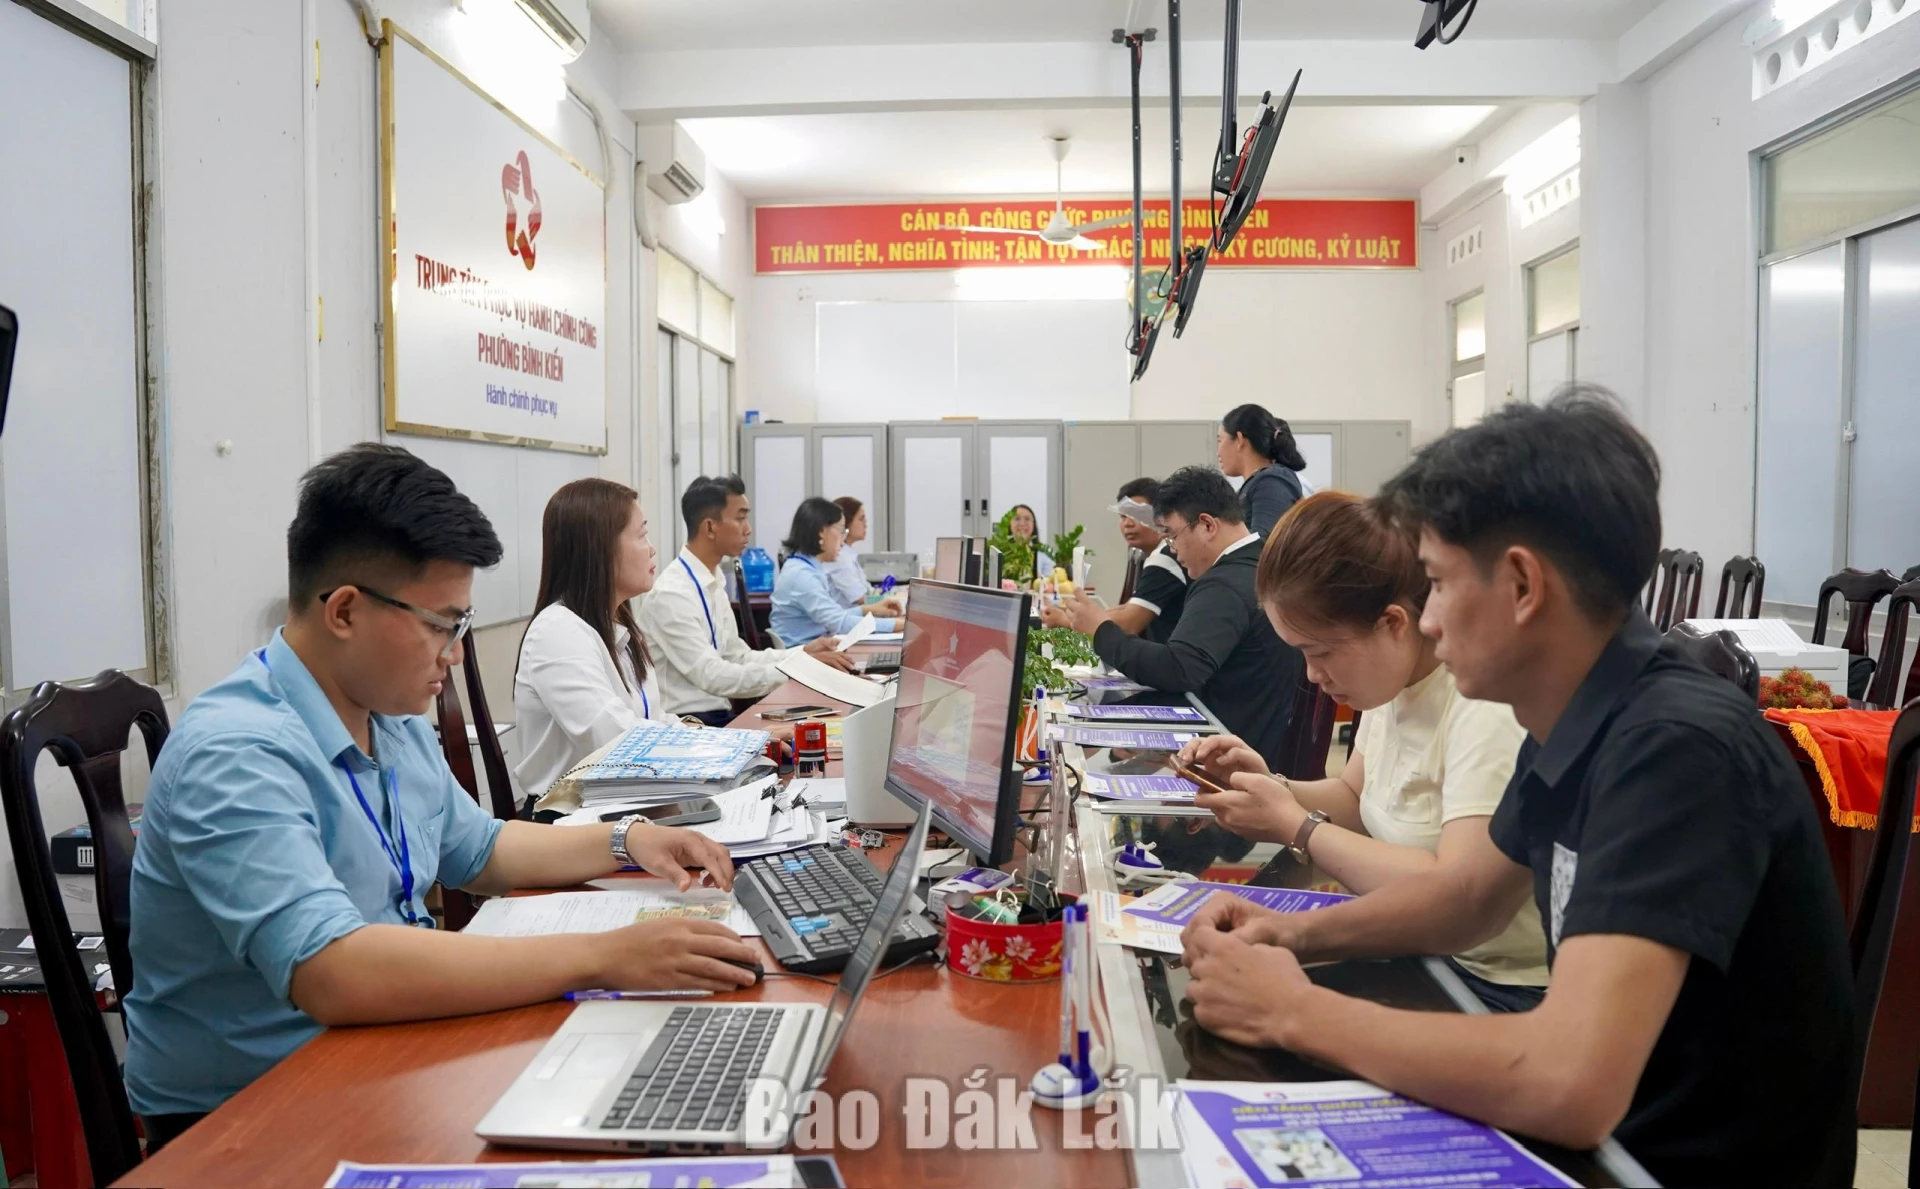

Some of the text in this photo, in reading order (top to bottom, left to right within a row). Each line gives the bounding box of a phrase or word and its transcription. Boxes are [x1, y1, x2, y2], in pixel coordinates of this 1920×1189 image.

[901, 208, 940, 231] CÁN
[980, 207, 1032, 231] CÔNG
[1036, 206, 1087, 229] CỨC
[1092, 207, 1170, 228] PHƯNG
[771, 241, 819, 265] THÂN
[825, 239, 884, 266] THIỆN,
[889, 237, 947, 261] NGHĨA
[951, 237, 1000, 262] TÌNH;
[1004, 236, 1042, 264] TẬN
[1224, 232, 1248, 258] KỶ
[1252, 236, 1322, 260] CƯƠNG,
[1327, 233, 1350, 259] KỶ
[1355, 236, 1401, 263] LUẬT
[553, 308, 578, 343] CHÍNH
[578, 316, 597, 349] CÔNG
[478, 332, 564, 383] PHƯỜNG BÌNH KIẾN
[486, 383, 508, 406] Hành
[508, 388, 530, 410] chính
[530, 393, 549, 416] phục
